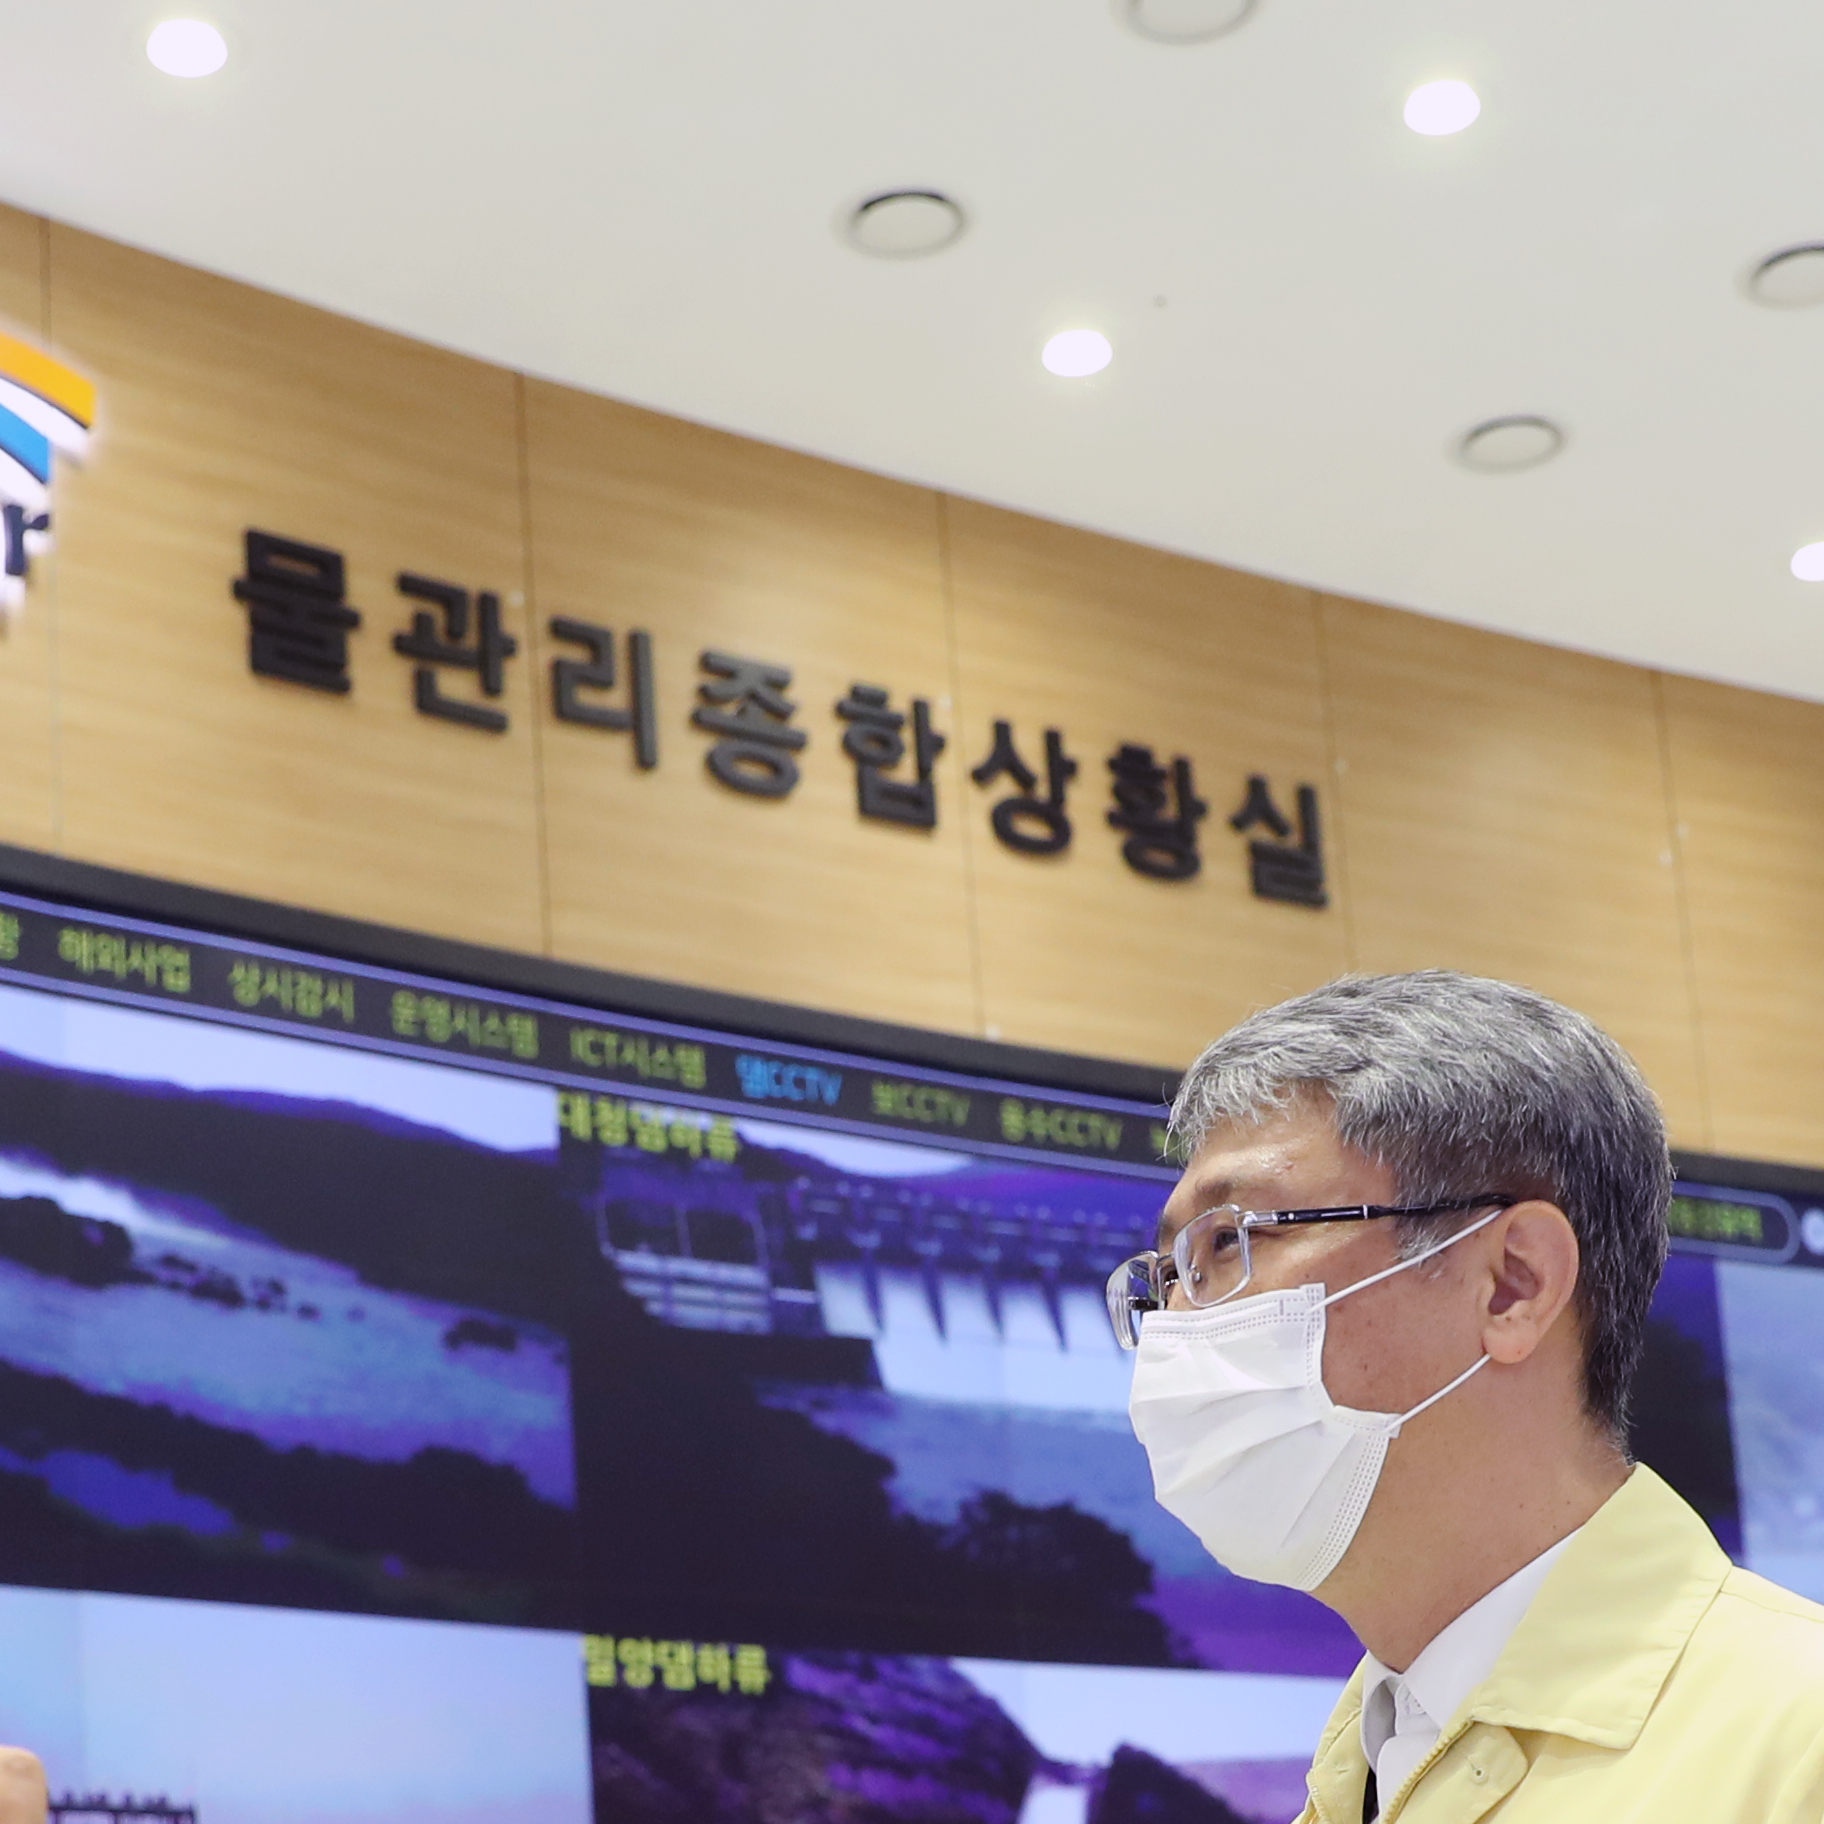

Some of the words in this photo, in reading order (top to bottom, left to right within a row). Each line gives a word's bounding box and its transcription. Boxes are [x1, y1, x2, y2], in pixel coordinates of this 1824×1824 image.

[231, 526, 1331, 911] 물관리종합상황실
[390, 990, 539, 1060] 운영시스템
[570, 1027, 707, 1090] ICT시스템
[736, 1054, 842, 1105] 댐CCTV
